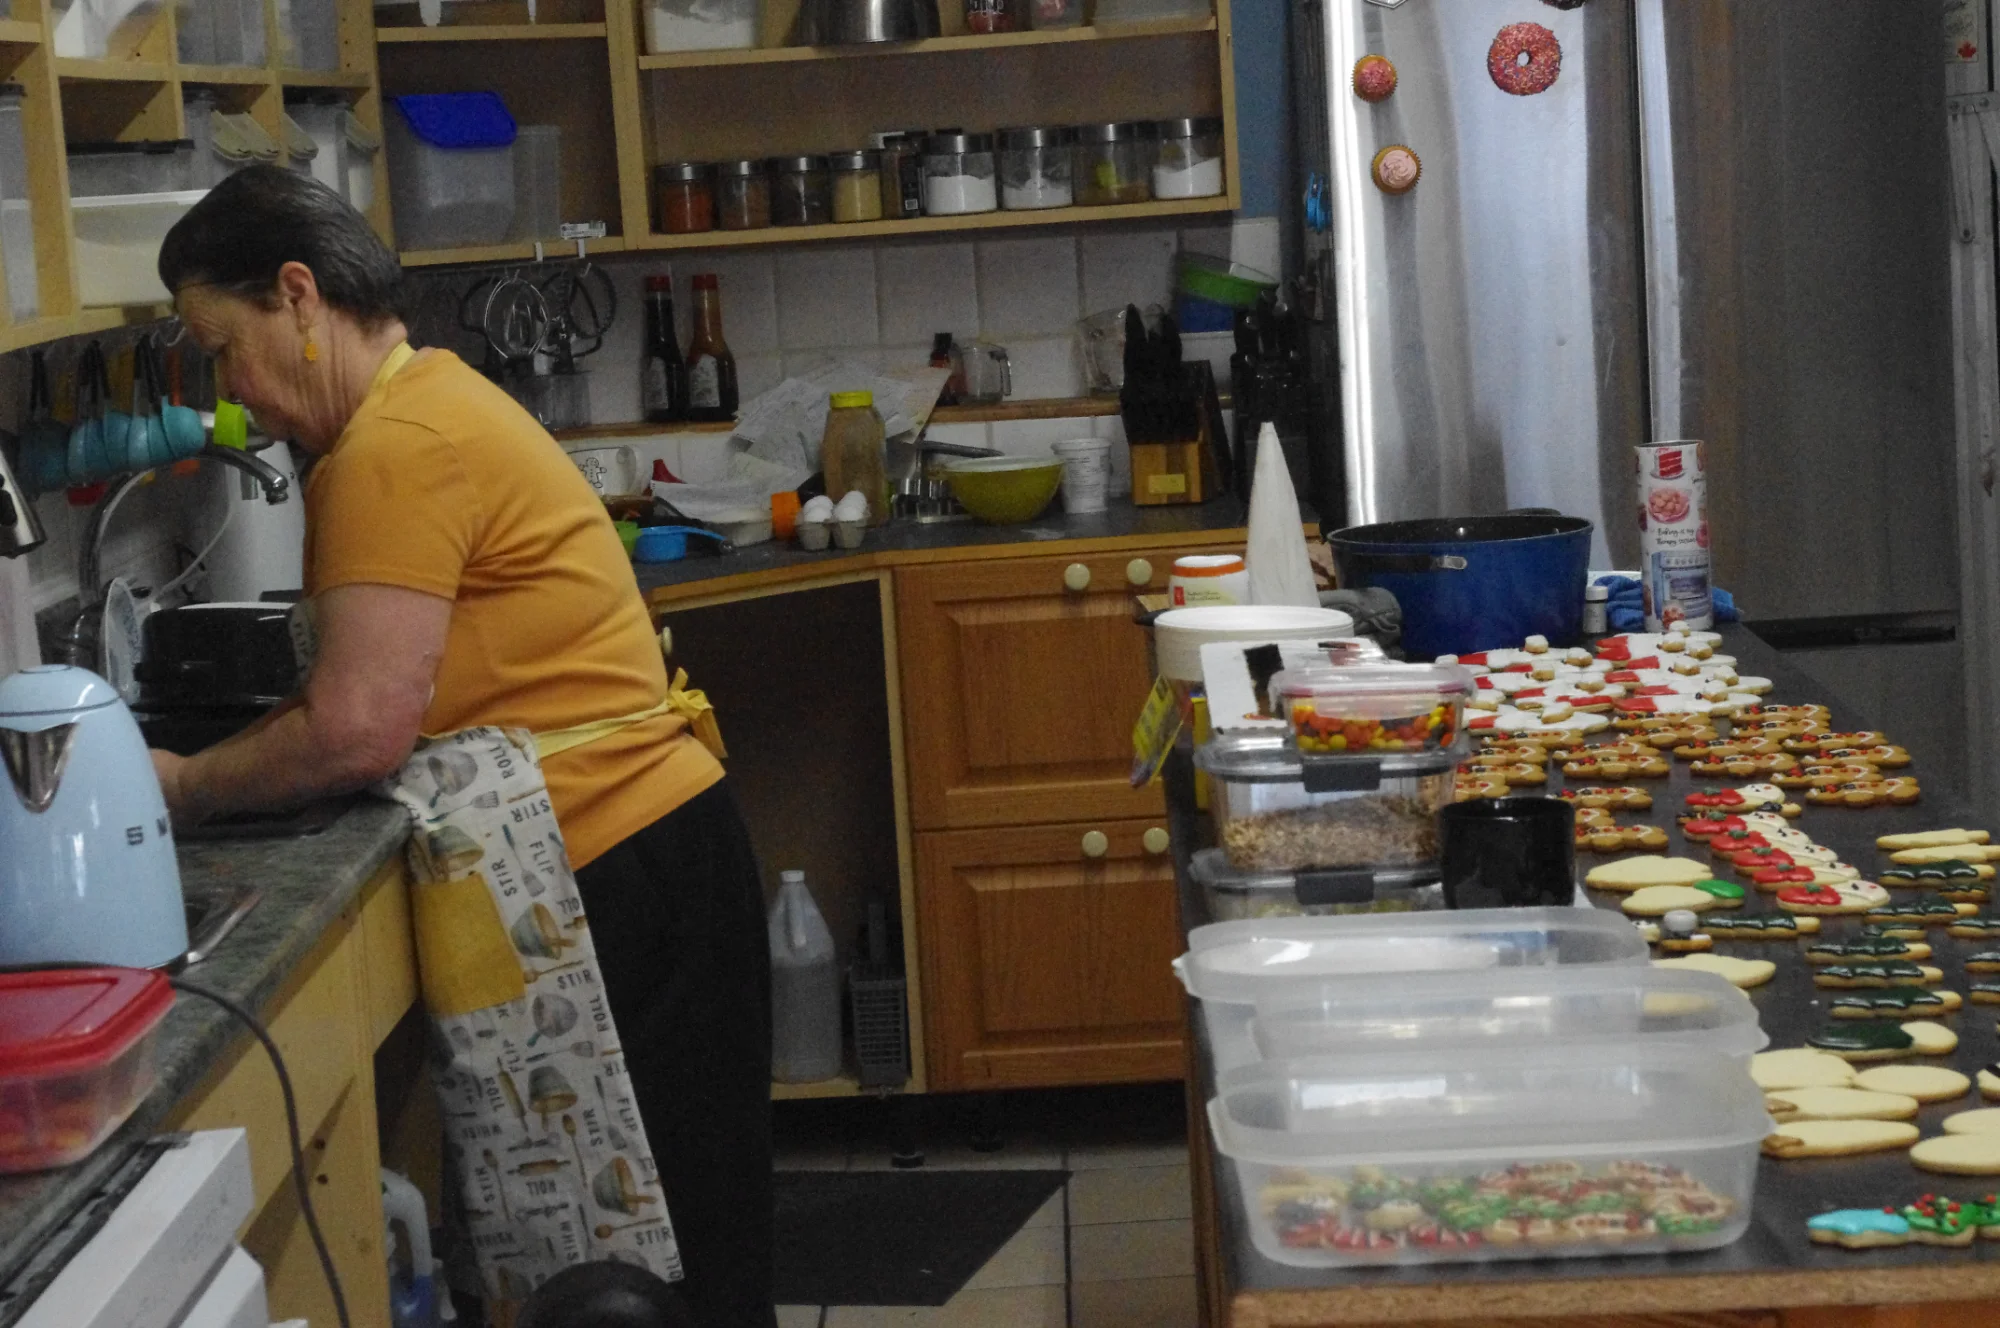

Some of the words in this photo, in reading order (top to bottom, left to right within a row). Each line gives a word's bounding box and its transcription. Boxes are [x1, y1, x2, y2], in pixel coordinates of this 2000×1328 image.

[489, 743, 515, 779] ROLL
[510, 799, 551, 823] STIR
[529, 840, 555, 876] FLIP
[491, 858, 517, 897] STIR
[556, 897, 580, 914] OLL
[557, 968, 593, 990] STIR
[589, 993, 610, 1032] ROLL
[582, 1108, 604, 1147] STIR
[617, 1097, 639, 1132] FLIP
[559, 1220, 580, 1262] WHIS
[634, 1226, 673, 1246] STIR
[664, 1251, 684, 1280] OLL
